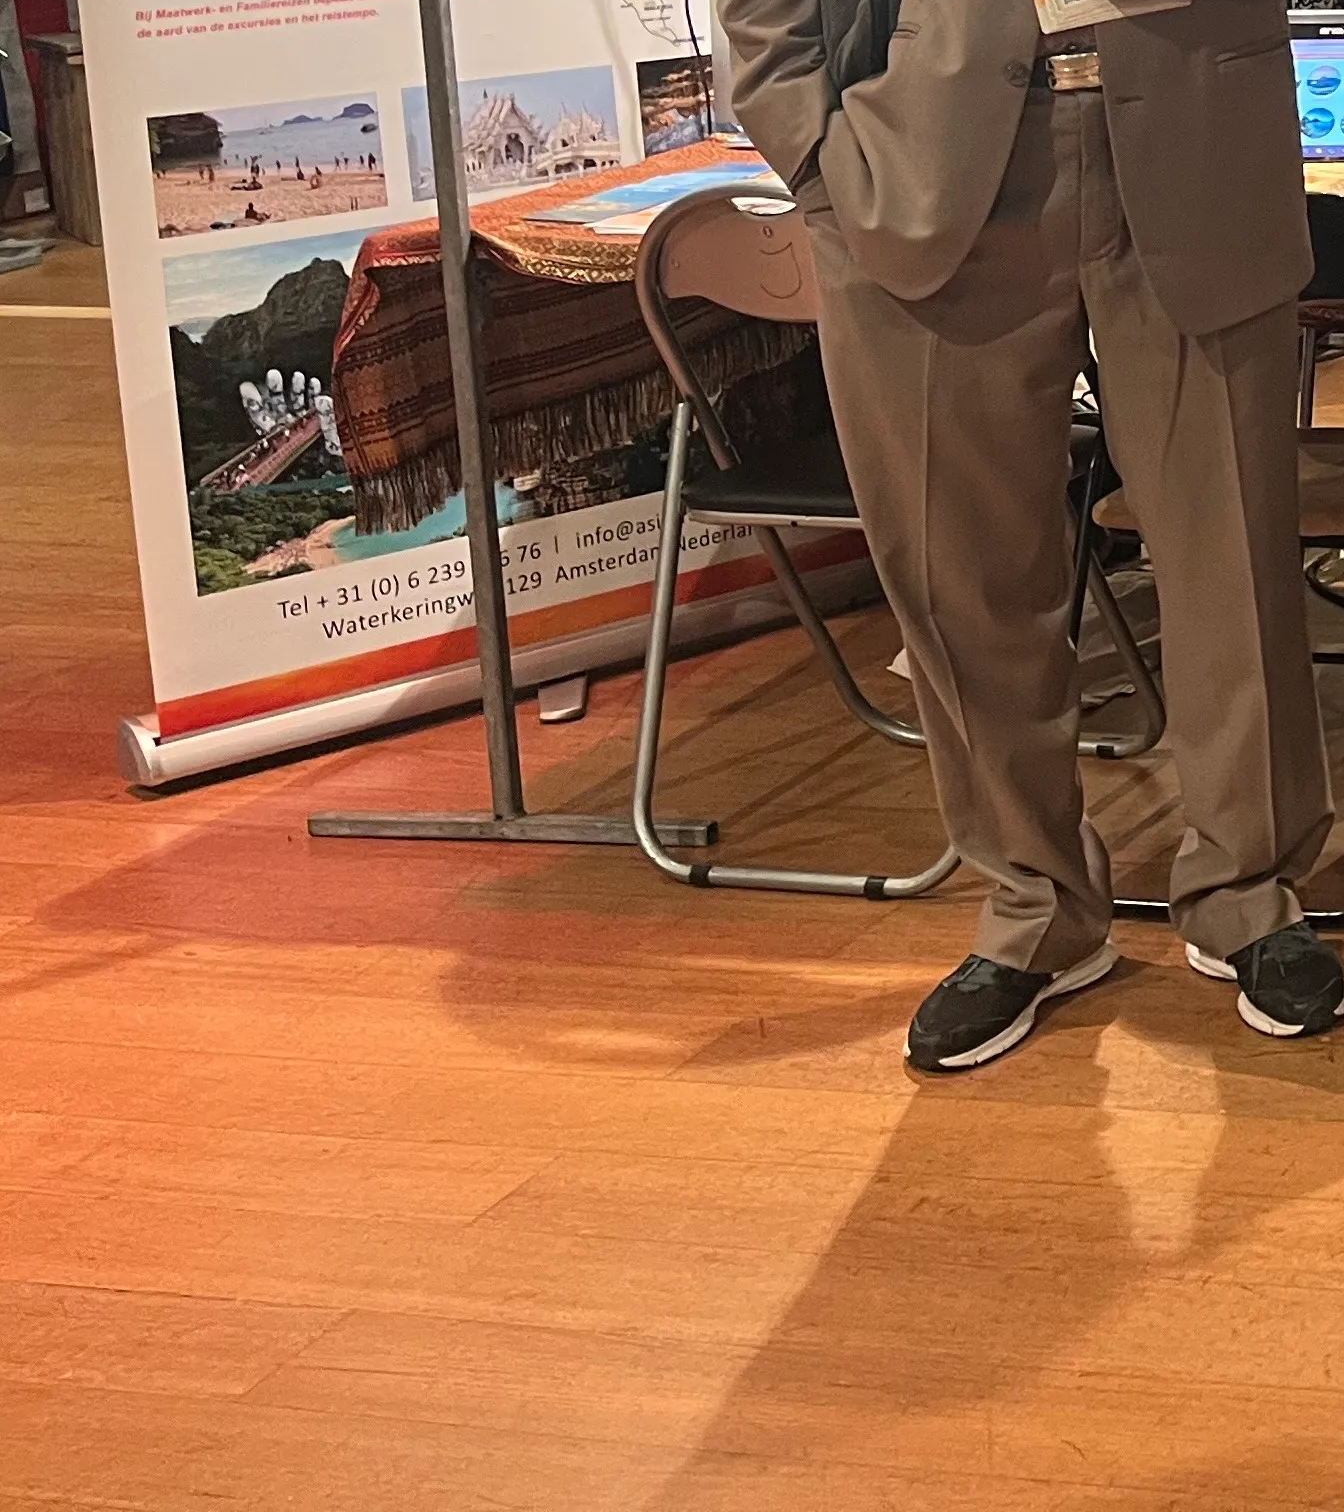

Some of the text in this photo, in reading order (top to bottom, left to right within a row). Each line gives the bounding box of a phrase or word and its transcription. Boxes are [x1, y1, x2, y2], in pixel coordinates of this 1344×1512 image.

[277, 596, 309, 619] Tel
[337, 584, 364, 606] 31
[371, 574, 400, 601] (0)
[408, 570, 420, 589] 6
[428, 560, 466, 584] 239
[517, 541, 542, 563] 76
[506, 571, 542, 595] 129
